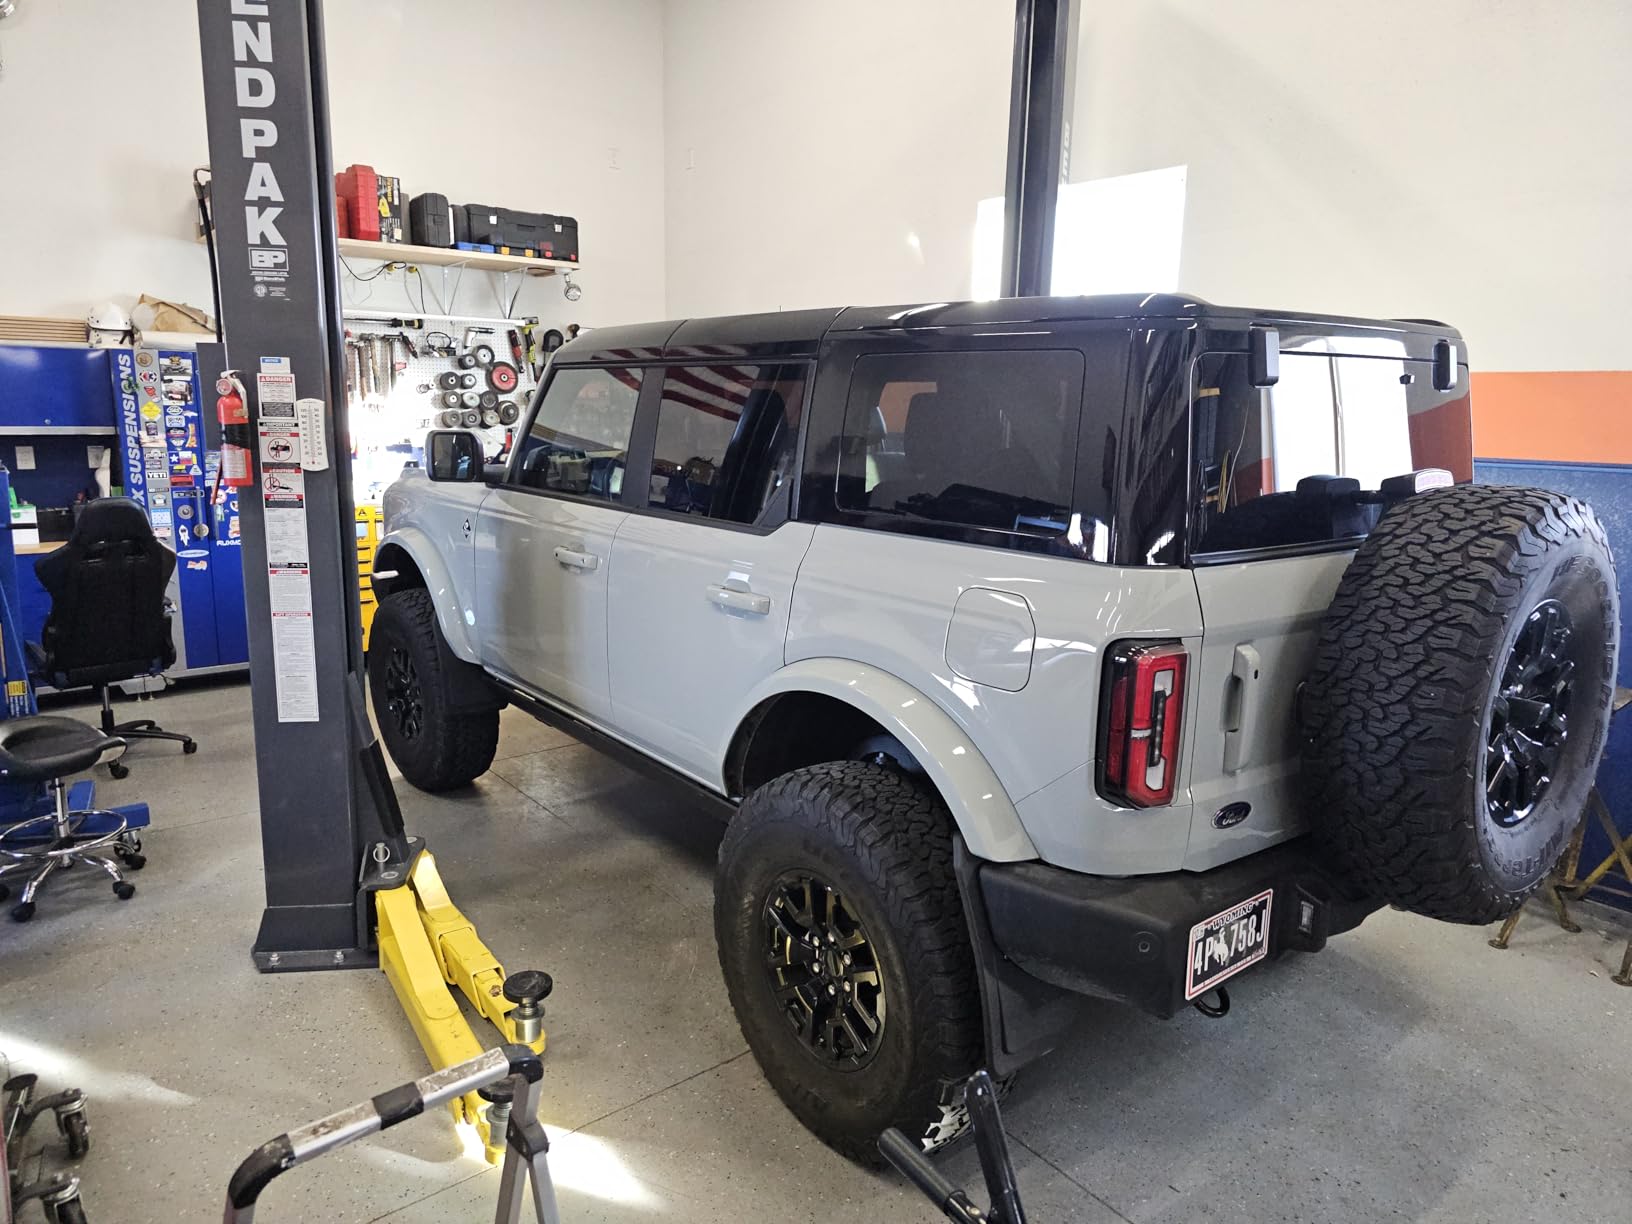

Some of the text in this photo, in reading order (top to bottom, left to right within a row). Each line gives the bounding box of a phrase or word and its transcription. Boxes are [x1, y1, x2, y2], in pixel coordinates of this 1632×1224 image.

[118, 353, 143, 485] SUSPENSIONS
[1194, 936, 1214, 976] 4P
[1230, 909, 1266, 957] 758J
[1212, 903, 1254, 930] WYOMING
